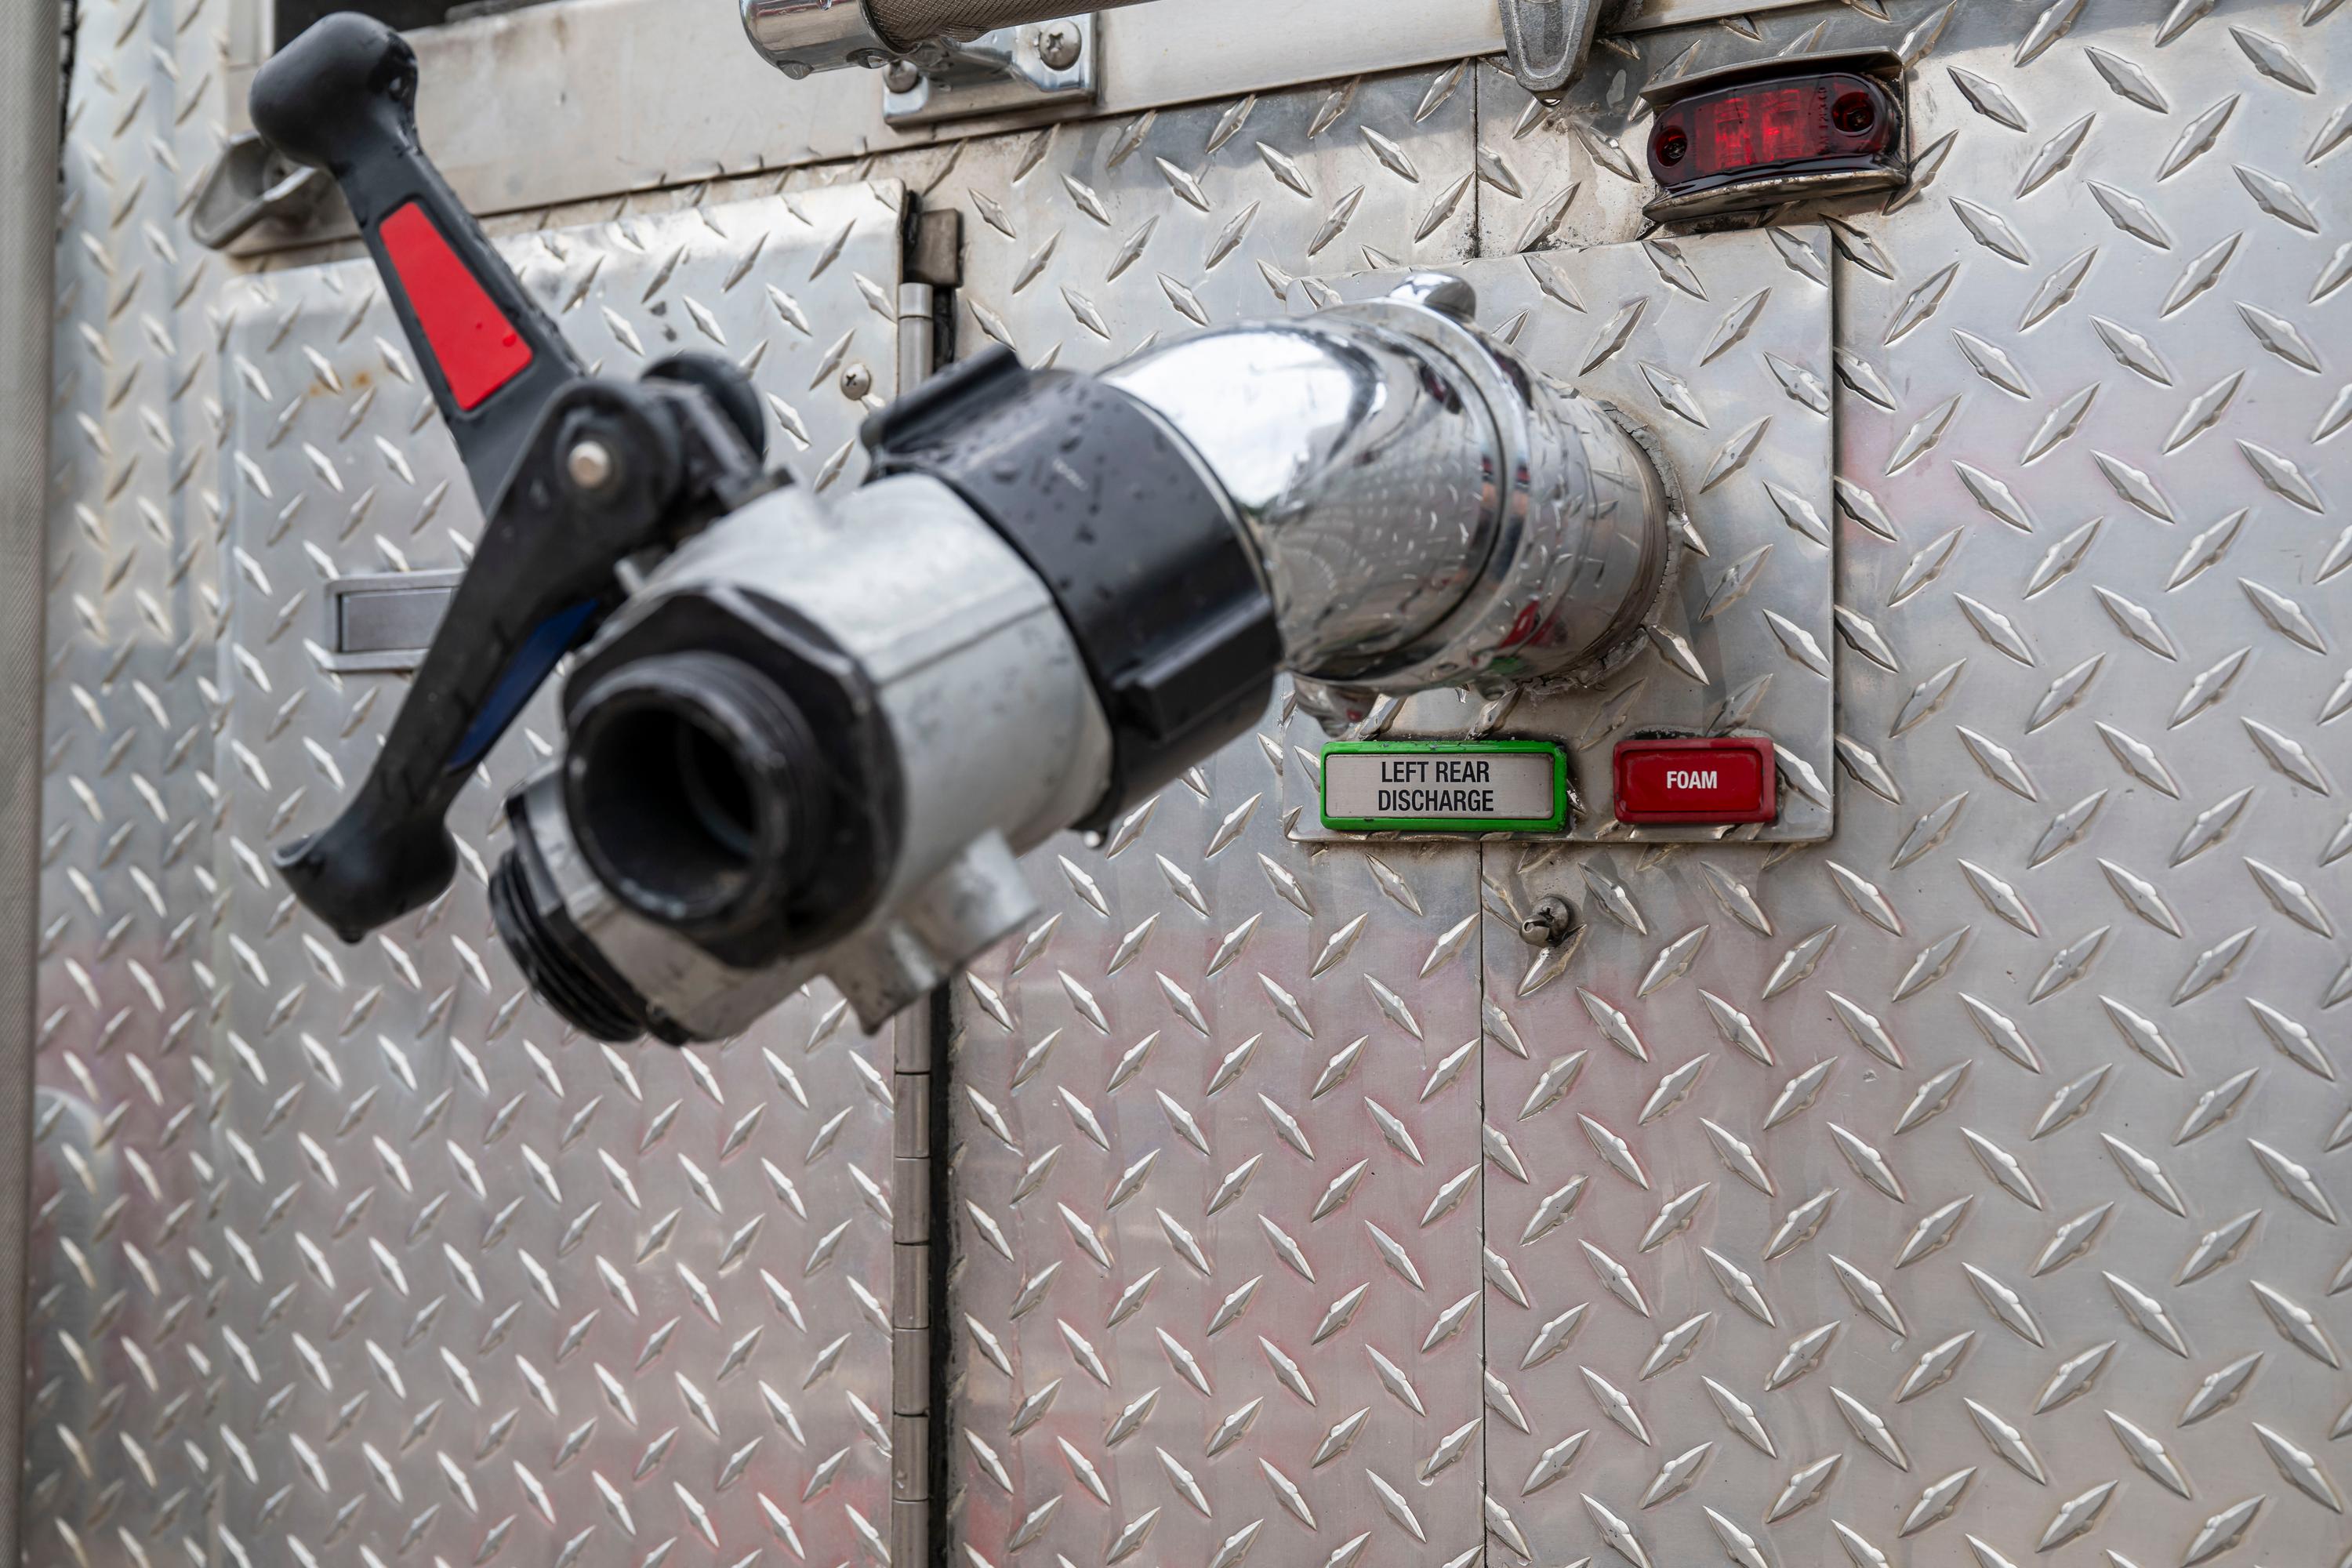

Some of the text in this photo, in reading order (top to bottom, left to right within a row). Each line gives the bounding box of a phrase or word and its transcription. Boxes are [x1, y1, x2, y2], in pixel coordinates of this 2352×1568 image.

[1381, 761, 1490, 782] LEFT REAR
[1666, 770, 1718, 789] FOAM
[1378, 789, 1494, 811] DISCHARGE
